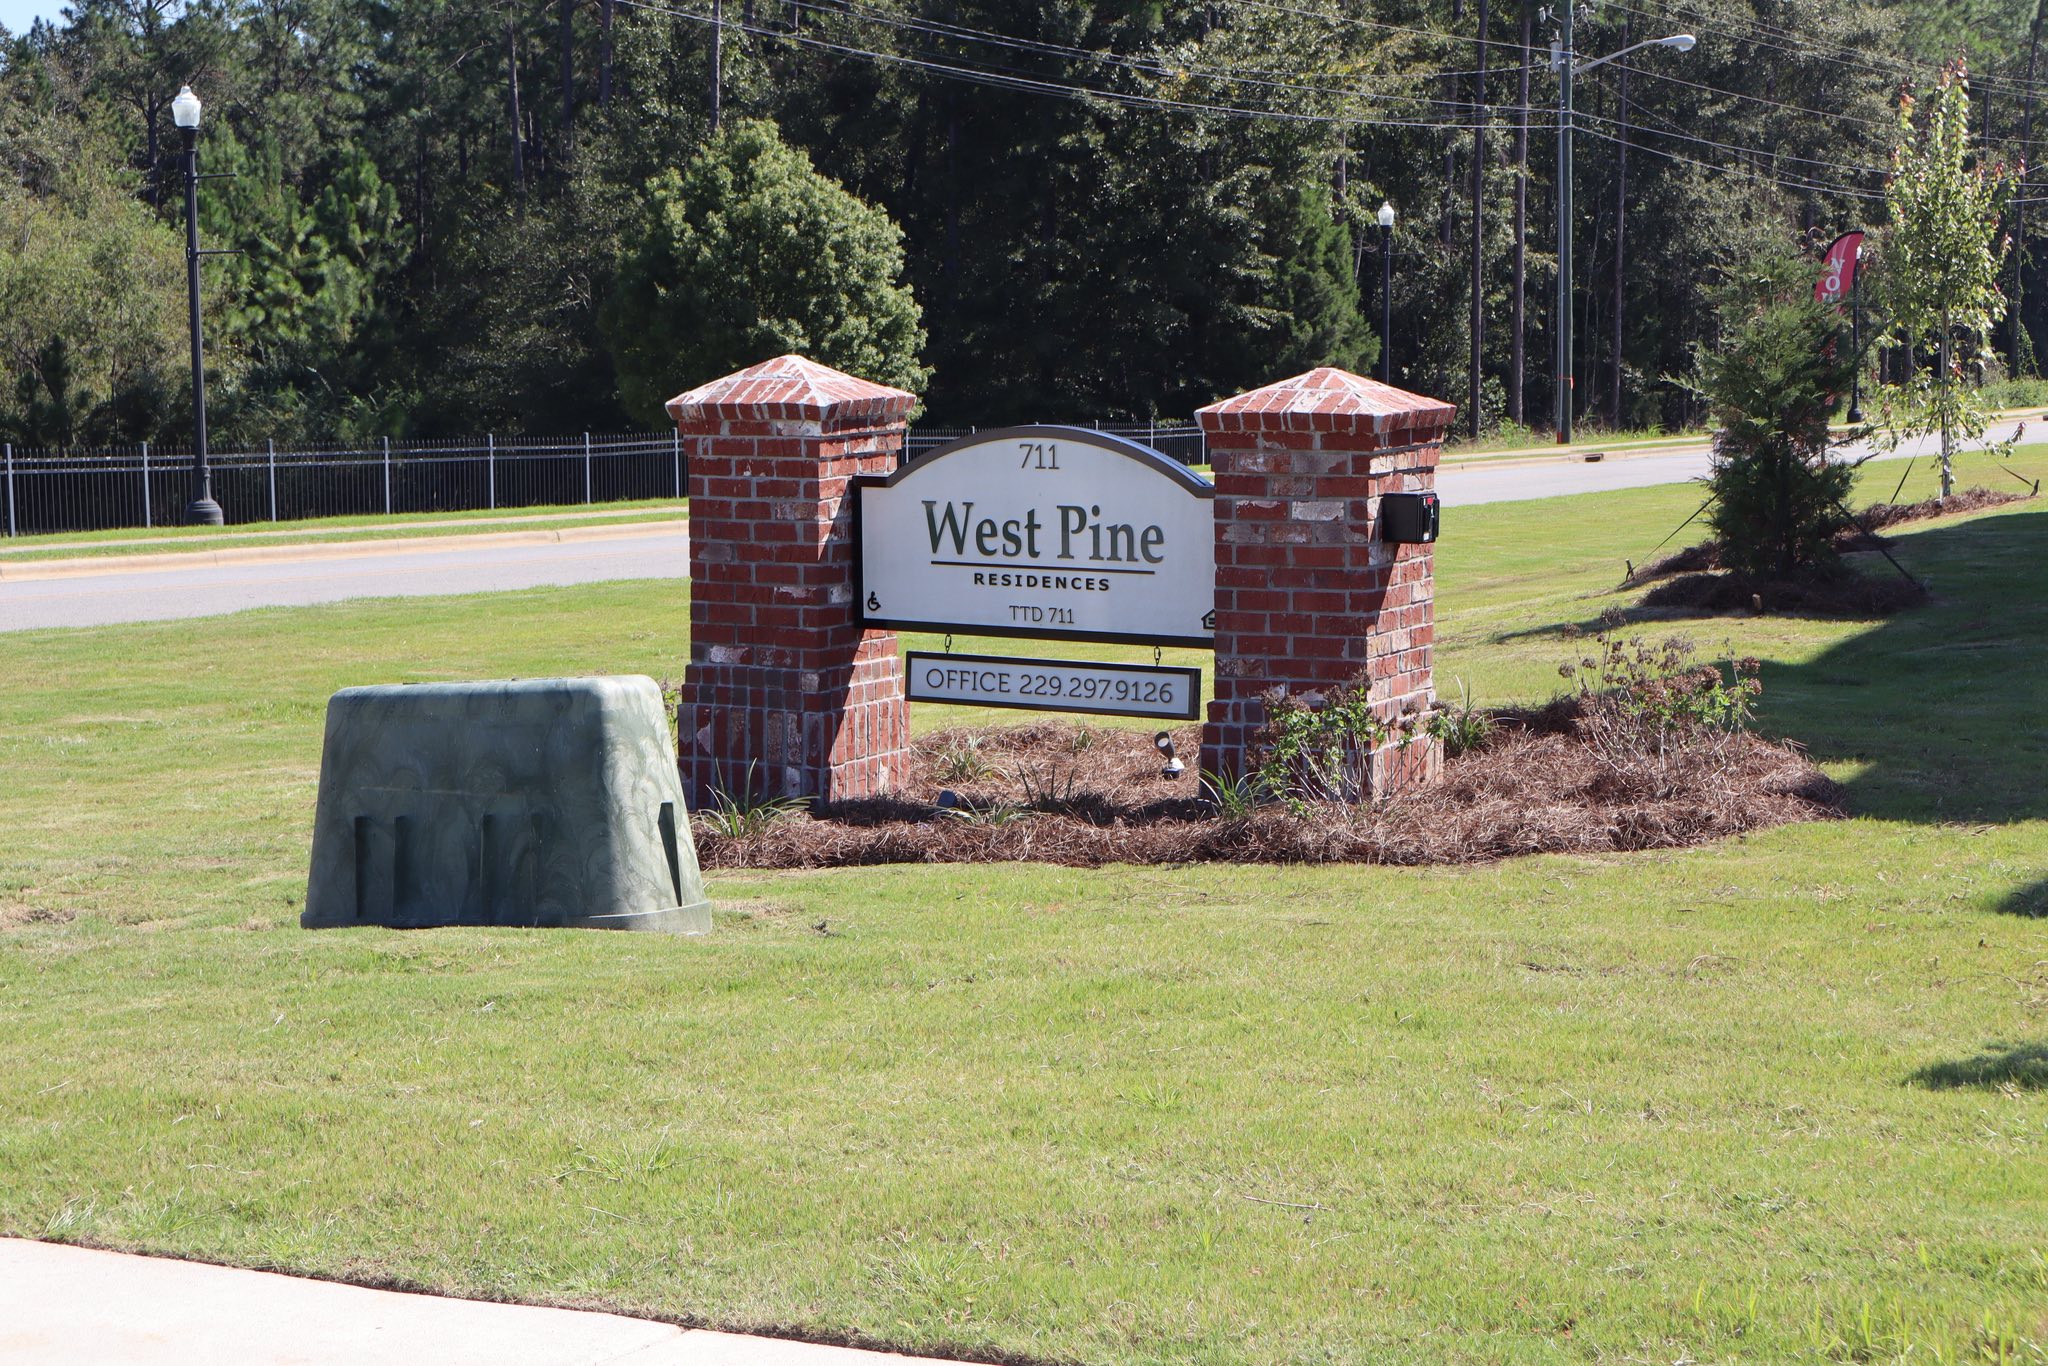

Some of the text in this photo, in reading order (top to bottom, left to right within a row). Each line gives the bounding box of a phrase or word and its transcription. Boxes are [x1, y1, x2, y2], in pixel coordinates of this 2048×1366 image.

[1019, 444, 1060, 470] 711
[921, 500, 1164, 564] West Pine
[973, 572, 1110, 591] RESIDENCES
[1009, 605, 1075, 624] TTD 711
[926, 668, 1173, 704] OFFICE 229.297.9126
